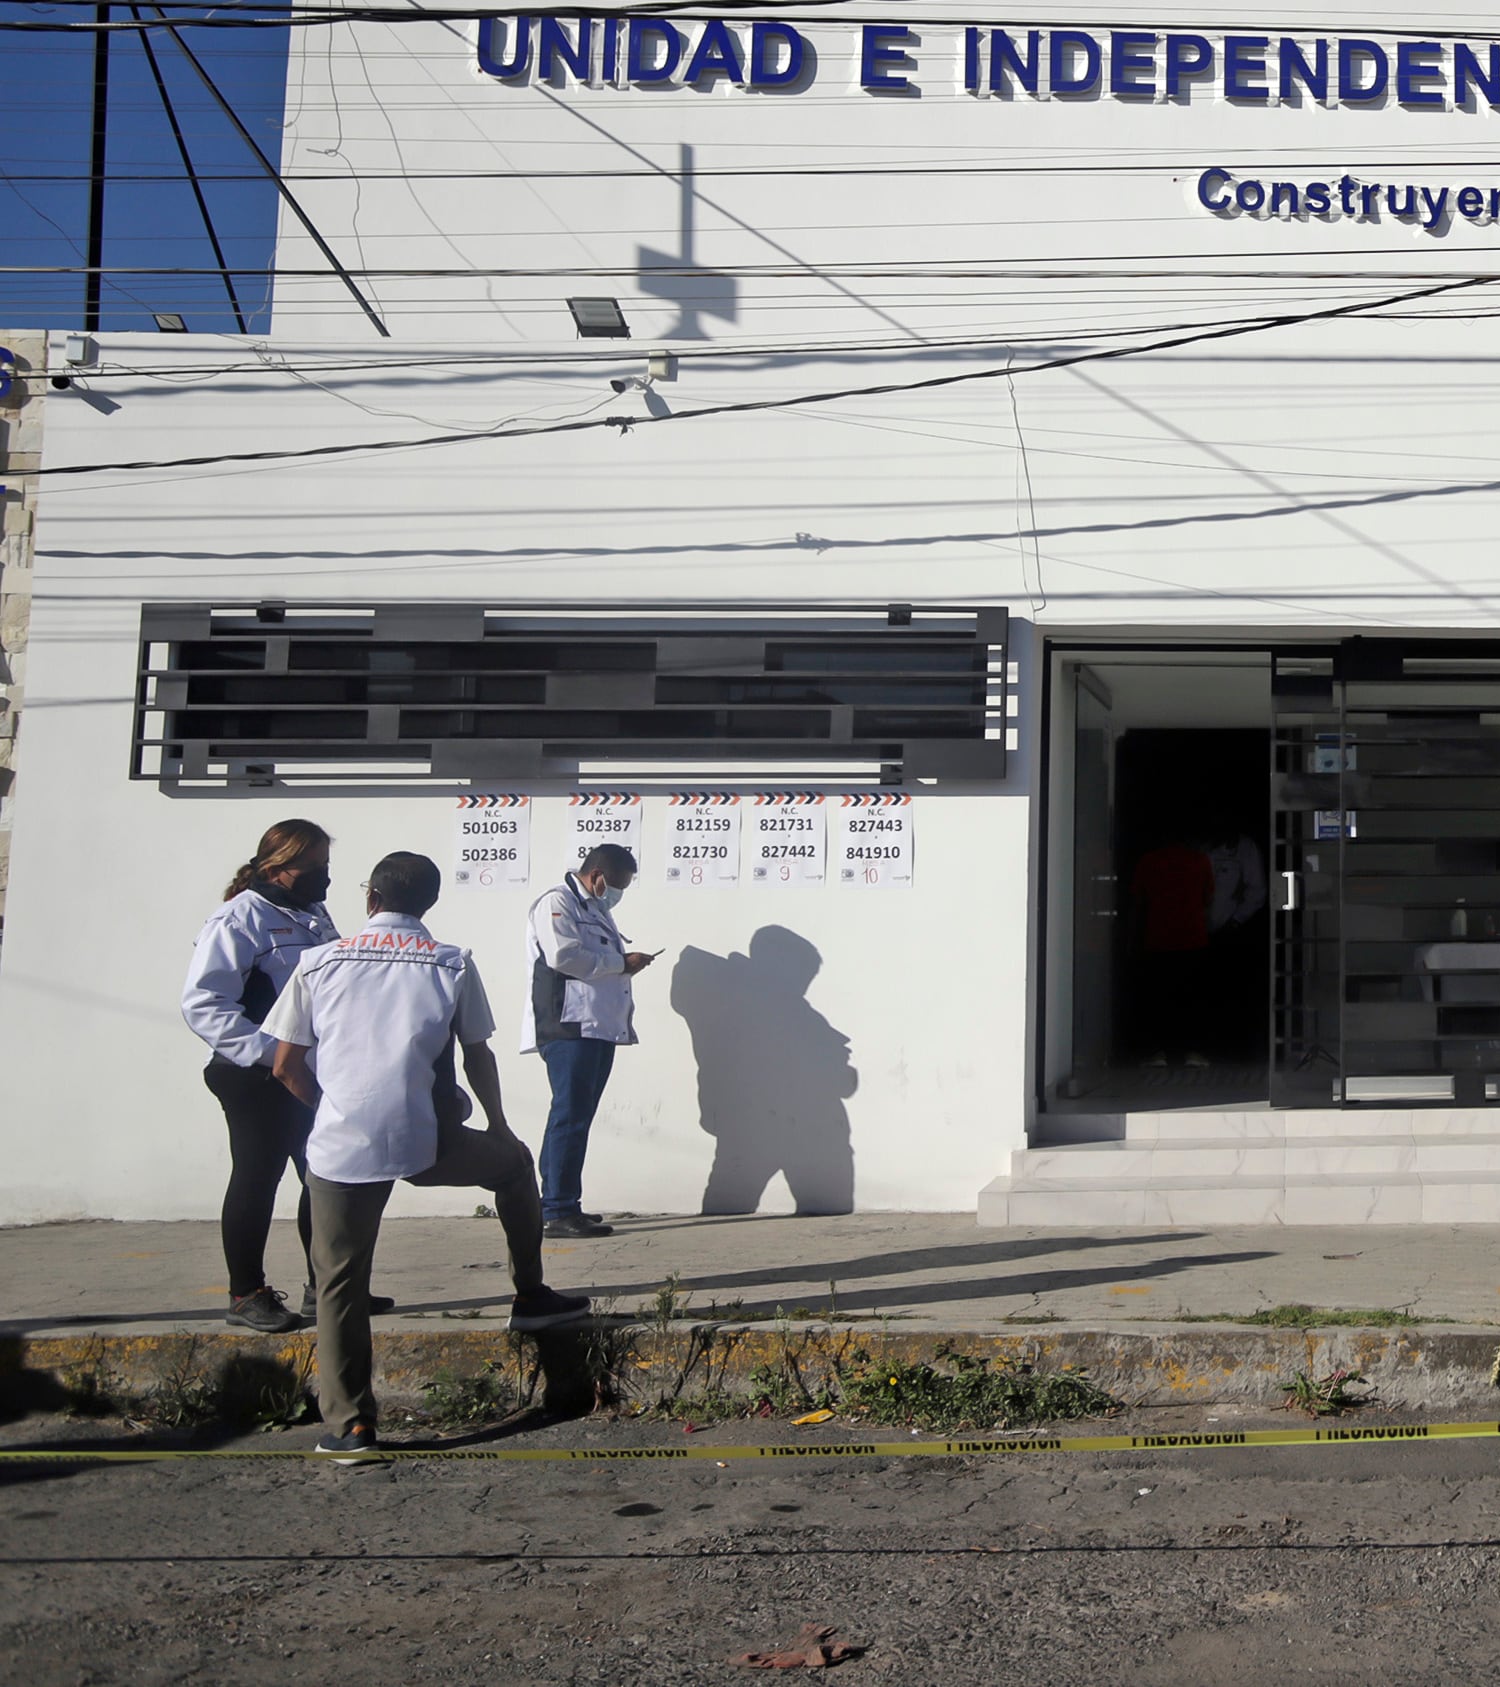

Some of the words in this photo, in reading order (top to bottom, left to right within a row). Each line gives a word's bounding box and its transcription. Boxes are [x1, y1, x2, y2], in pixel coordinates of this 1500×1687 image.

[479, 18, 804, 84] UNIDAD
[862, 26, 908, 87] E
[463, 821, 517, 834] 501063
[577, 820, 631, 832] 502387
[676, 819, 731, 831] 812159
[760, 819, 813, 831] 821731
[849, 820, 902, 832] 827443
[462, 848, 517, 861] 502386
[673, 846, 727, 858] 821730
[762, 846, 815, 857] 827442
[846, 847, 900, 859] 841910
[480, 868, 493, 886] 6
[691, 866, 702, 885] 8
[780, 866, 790, 881] 9
[861, 868, 878, 884] 10
[336, 933, 437, 951] SITIAVW
